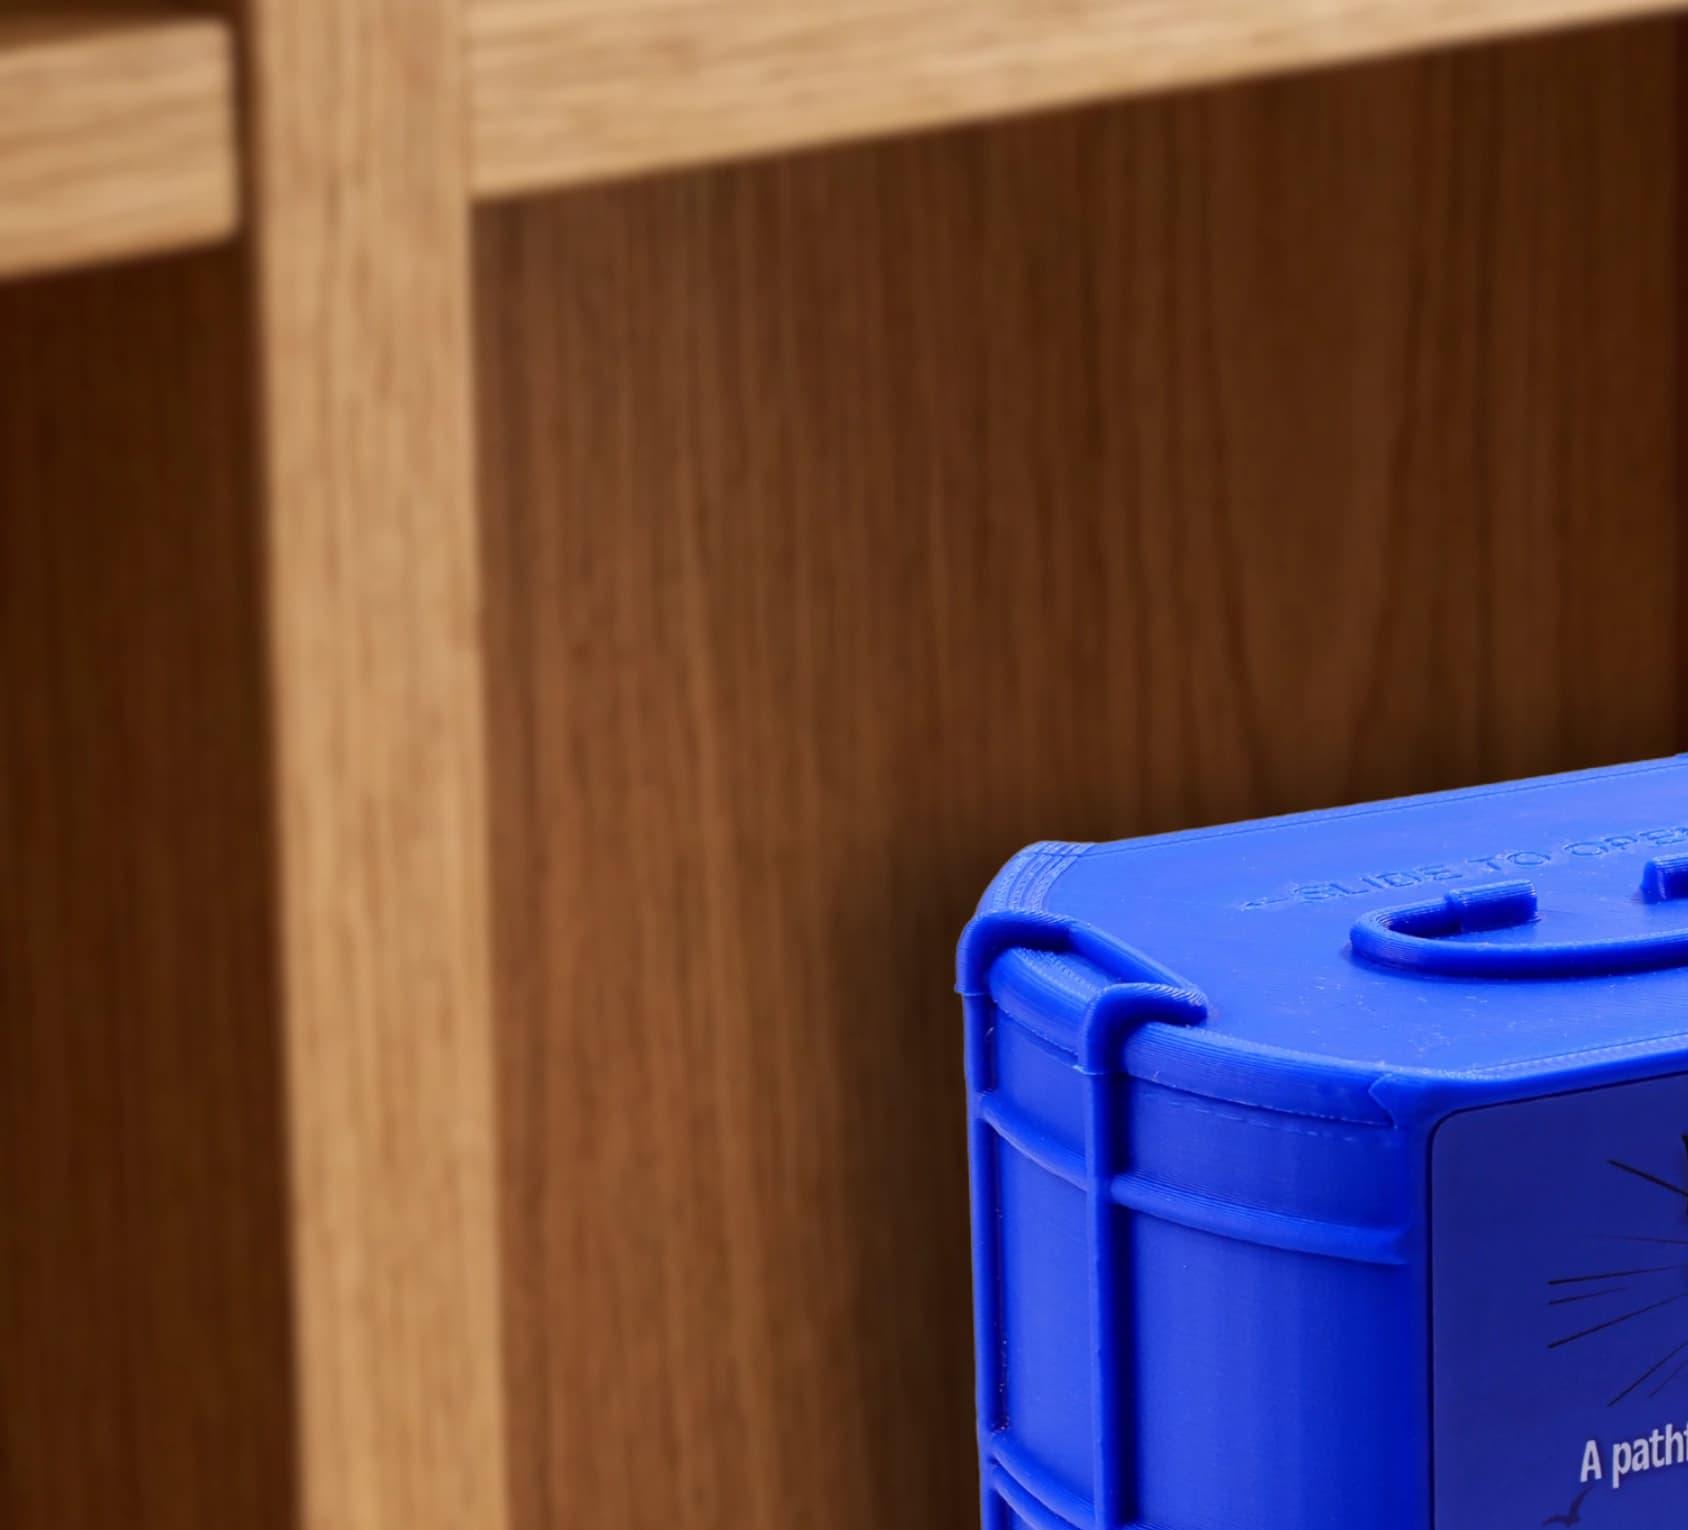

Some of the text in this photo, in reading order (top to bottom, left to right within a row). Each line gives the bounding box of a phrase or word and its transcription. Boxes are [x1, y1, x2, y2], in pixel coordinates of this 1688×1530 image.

[1294, 866, 1463, 901] SLIDE
[1474, 851, 1551, 870] TO
[1580, 1439, 1602, 1482] A
